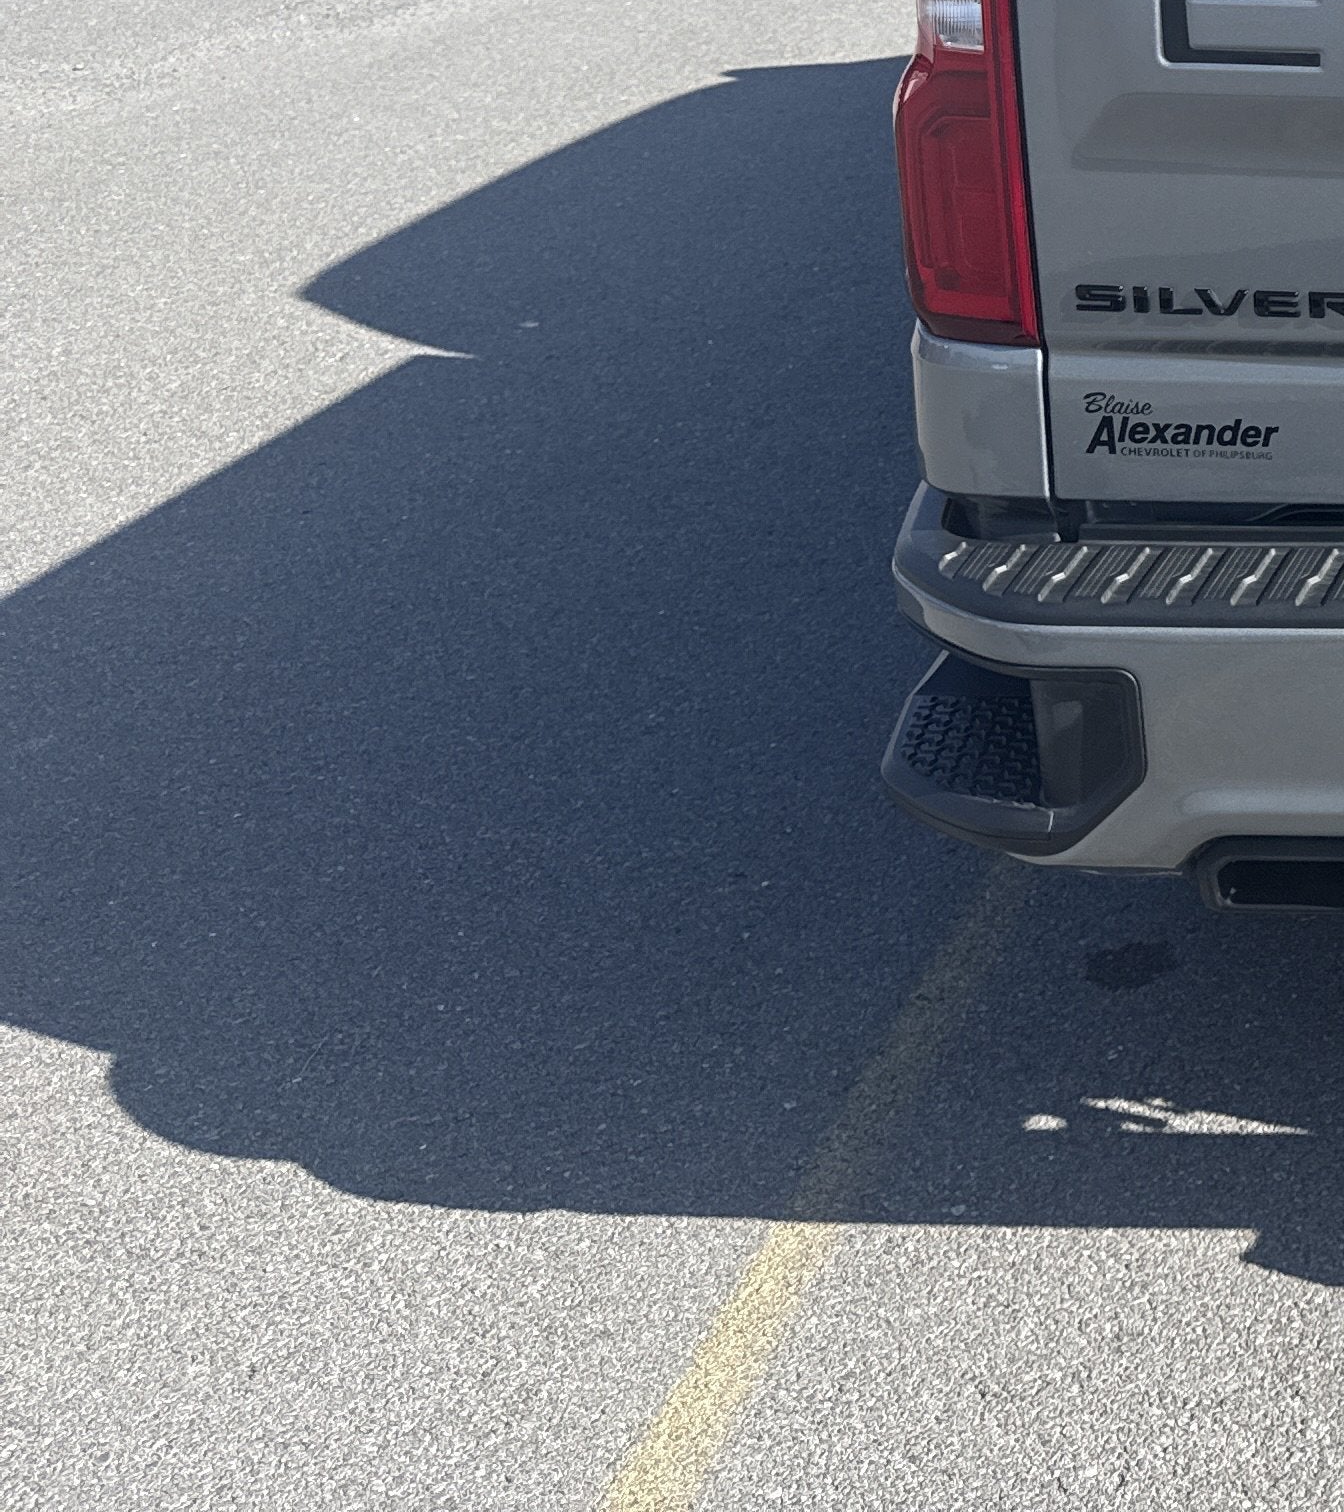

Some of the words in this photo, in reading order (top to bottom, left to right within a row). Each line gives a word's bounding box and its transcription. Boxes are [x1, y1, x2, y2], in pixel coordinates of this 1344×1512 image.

[1083, 392, 1153, 415] Blaise
[1085, 415, 1280, 455] Alexander
[1120, 446, 1190, 458] CHEVROLET
[1193, 449, 1207, 458] OF
